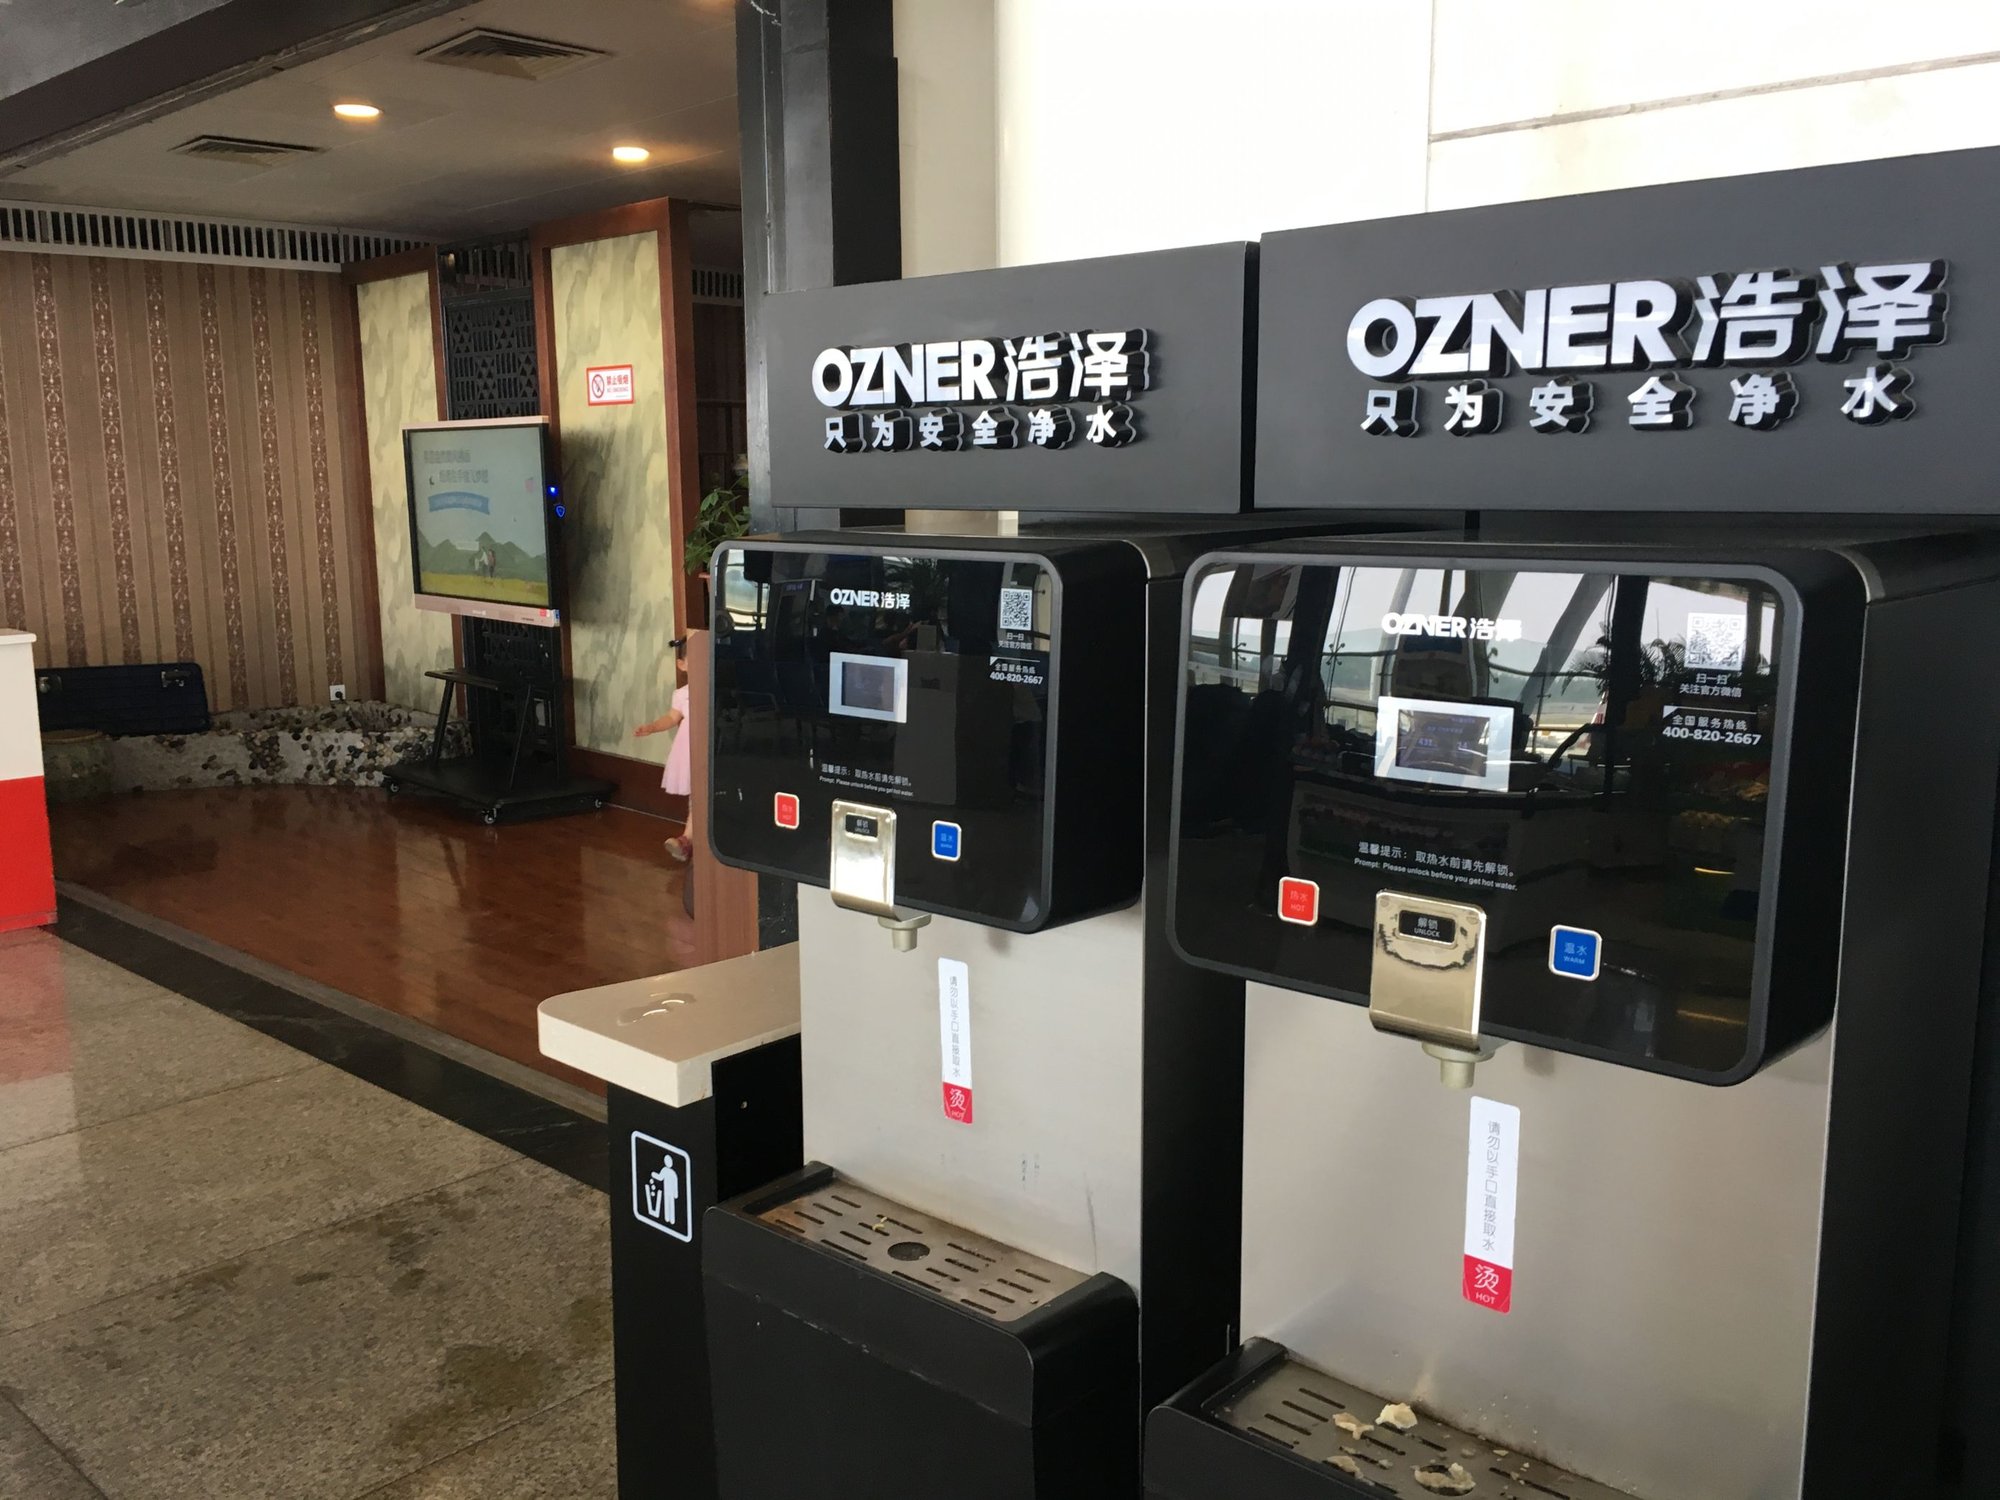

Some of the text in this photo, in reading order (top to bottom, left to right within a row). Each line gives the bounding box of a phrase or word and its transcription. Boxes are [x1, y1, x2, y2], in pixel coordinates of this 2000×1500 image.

[1346, 262, 1938, 378] OZNER 浩泽
[811, 331, 1133, 408] OZNER 浩泽
[1360, 365, 1902, 433] 只为安全净水
[823, 404, 1119, 450] 只为安全净水
[829, 588, 880, 608] OZNER
[1381, 612, 1523, 643] OZNER 浩
[989, 671, 1044, 685] 400-820-2667
[1695, 672, 1729, 685] 扫一扫
[1679, 683, 1743, 698] 关注官方微信
[1671, 714, 1748, 732] 全国服务热线
[1662, 726, 1763, 746] 400-820-2667
[1353, 856, 1381, 869] Prompt:
[1382, 862, 1406, 873] Please
[1406, 866, 1430, 877] unlock
[1430, 869, 1454, 882] before
[1454, 874, 1468, 884] you
[1468, 875, 1481, 886] get
[1481, 877, 1494, 887] hot
[1290, 903, 1305, 912] HOT
[1413, 927, 1441, 938] UNLOCK
[1417, 916, 1439, 931] 解锁
[1564, 942, 1587, 956] 温水
[1563, 955, 1586, 964] WARM
[949, 1087, 967, 1112] 烫
[1482, 1121, 1501, 1251] 请勿以手口直接取水
[1473, 1262, 1500, 1297] 烫
[1475, 1291, 1496, 1306] HOT
